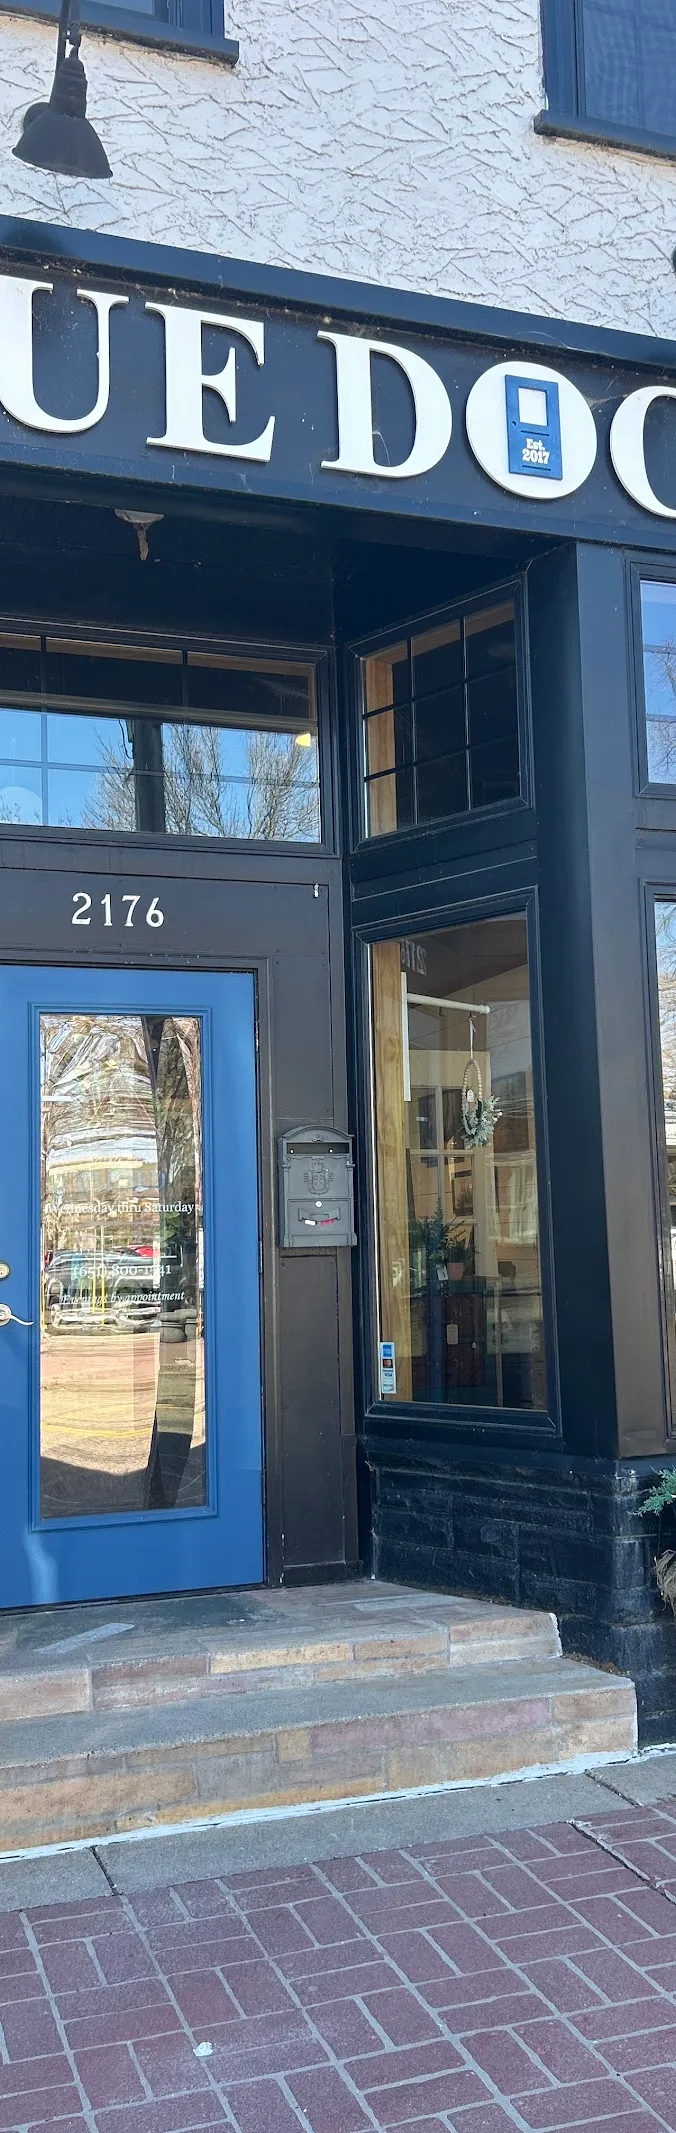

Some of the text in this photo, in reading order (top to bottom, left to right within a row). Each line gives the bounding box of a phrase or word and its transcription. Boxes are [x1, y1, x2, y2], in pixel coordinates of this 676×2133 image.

[526, 438, 546, 451] Est.
[522, 448, 550, 464] 2017
[71, 892, 164, 928] 2176
[43, 1200, 194, 1216] Wednesday thru Saturday
